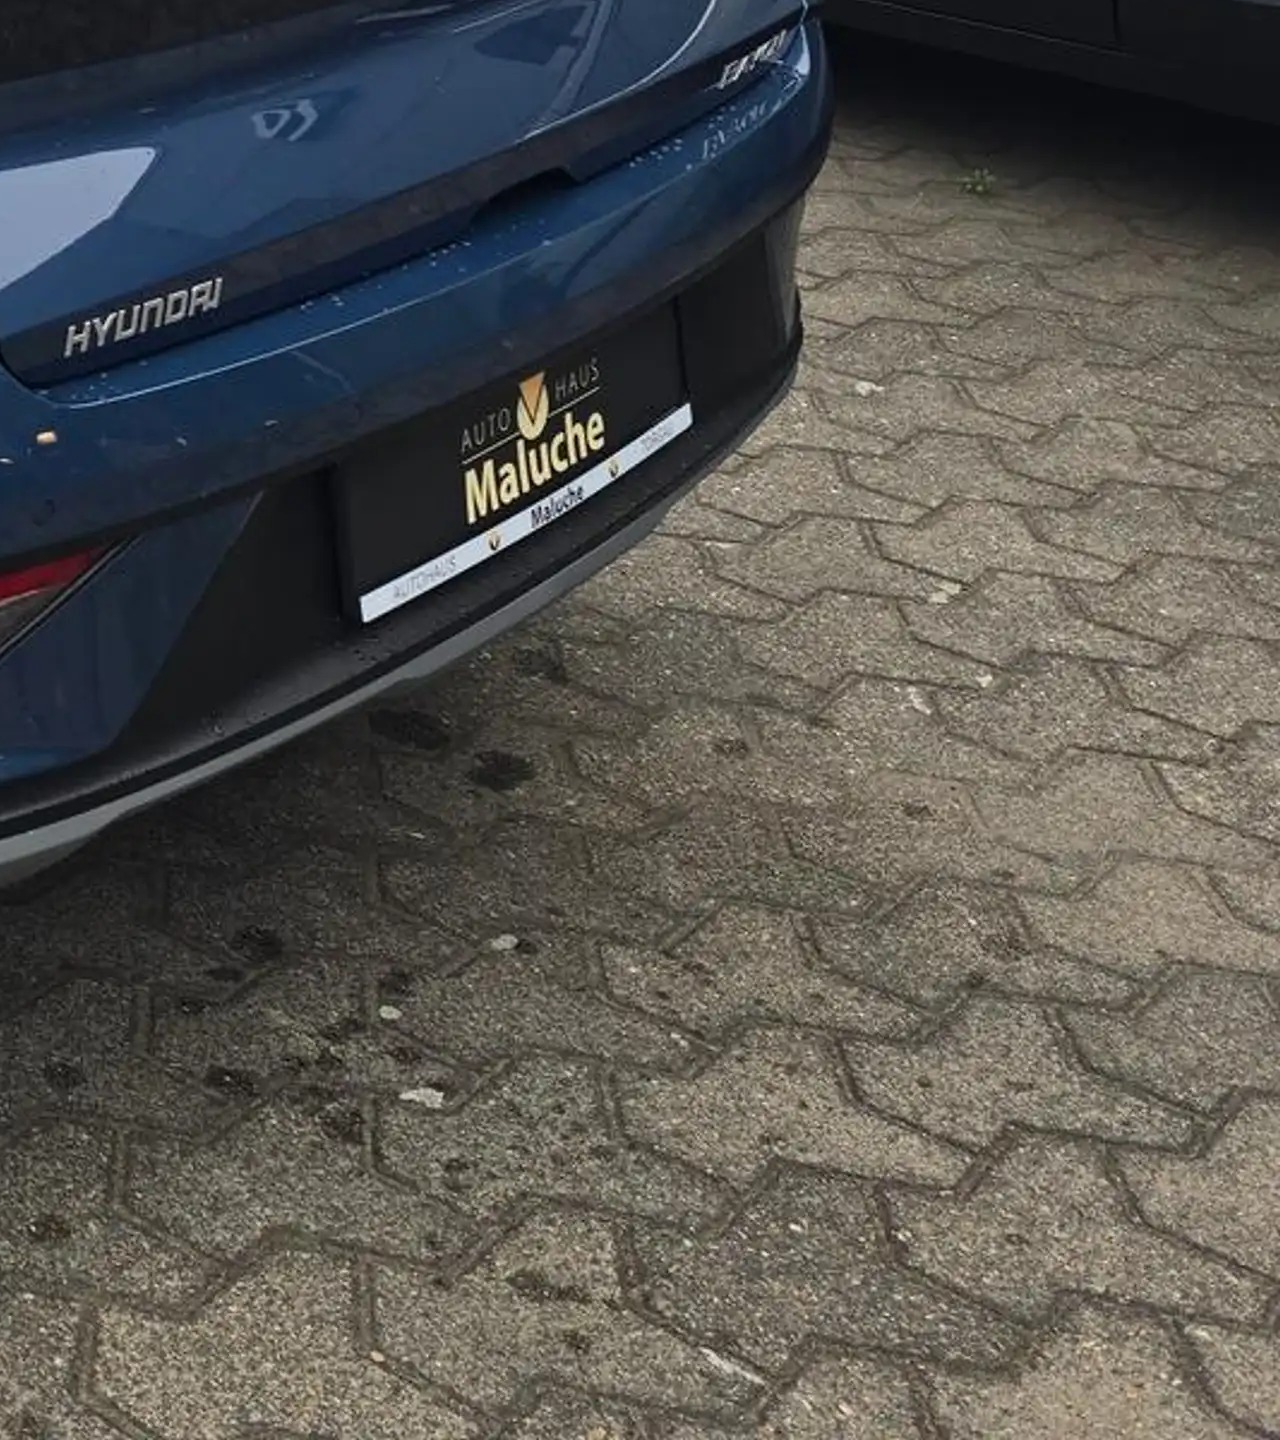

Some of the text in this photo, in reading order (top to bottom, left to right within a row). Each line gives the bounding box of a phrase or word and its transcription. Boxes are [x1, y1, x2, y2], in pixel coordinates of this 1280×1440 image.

[64, 277, 223, 358] HYUNDAI
[460, 359, 600, 454] AUTO HAUS
[463, 411, 606, 525] Maluche
[531, 485, 583, 529] Maluche
